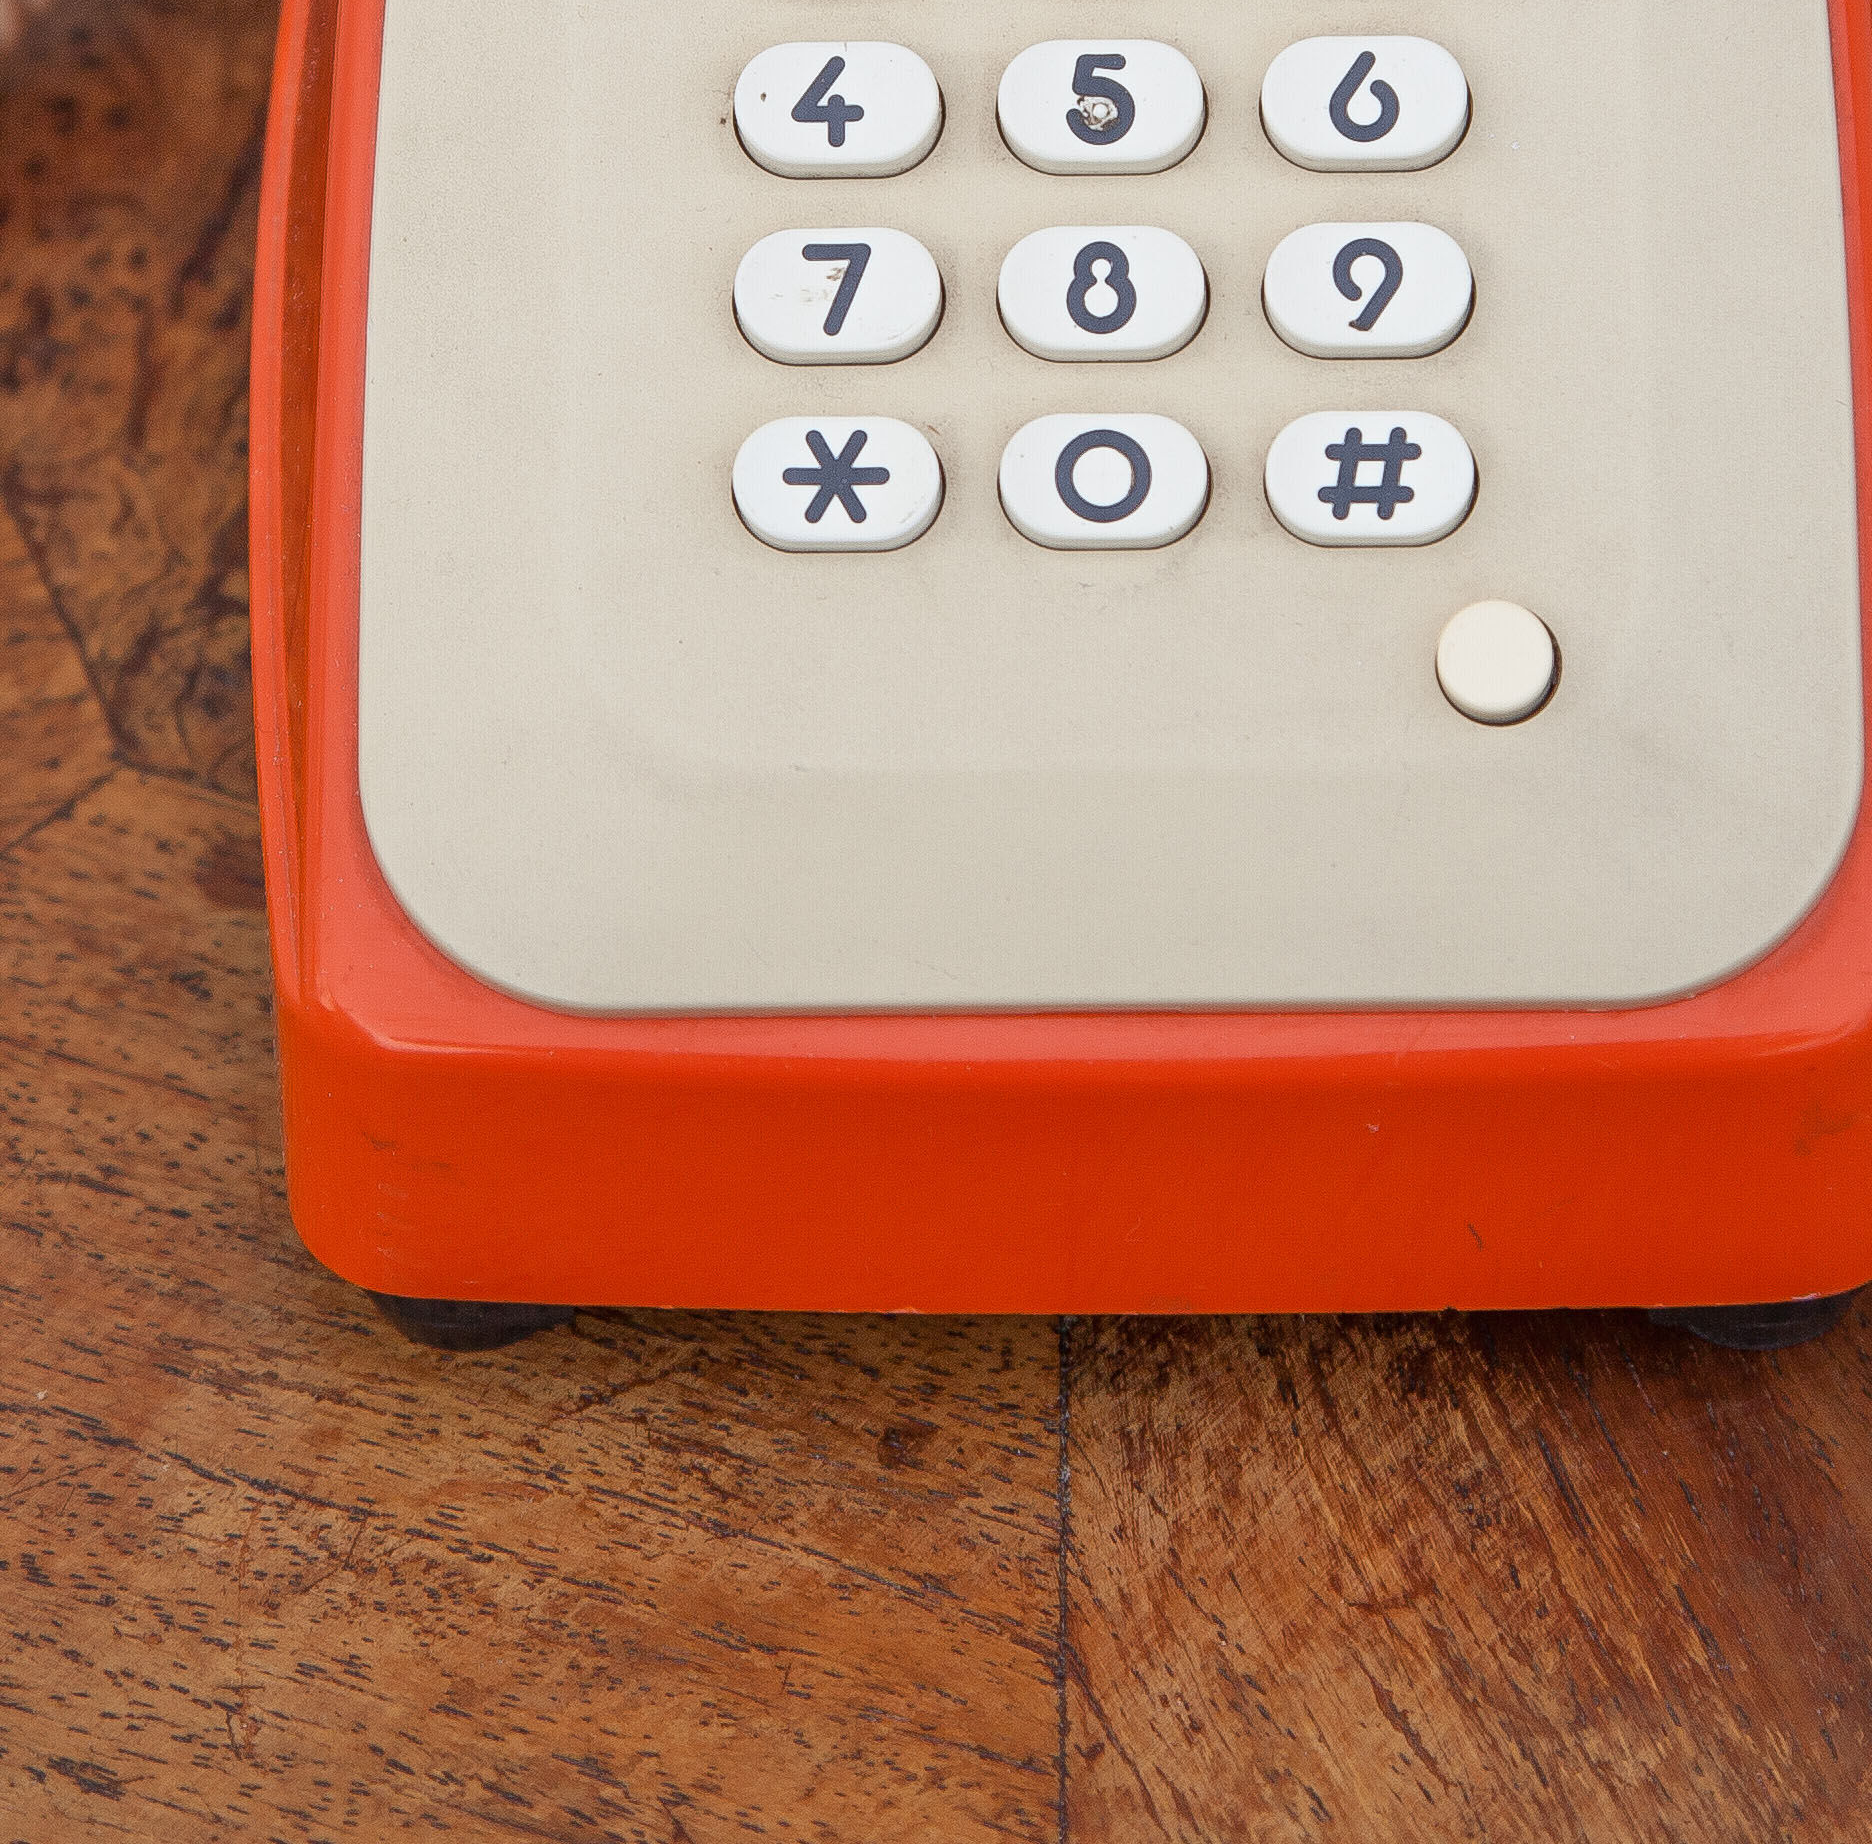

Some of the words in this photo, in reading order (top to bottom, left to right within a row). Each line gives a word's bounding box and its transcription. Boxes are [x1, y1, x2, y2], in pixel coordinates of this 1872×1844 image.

[790, 55, 865, 148] 4
[1065, 53, 1136, 146] 5
[1328, 50, 1400, 143] 6
[801, 243, 872, 337] 7
[1066, 241, 1137, 335] 8
[1332, 237, 1404, 332] 9
[1317, 426, 1422, 521] #
